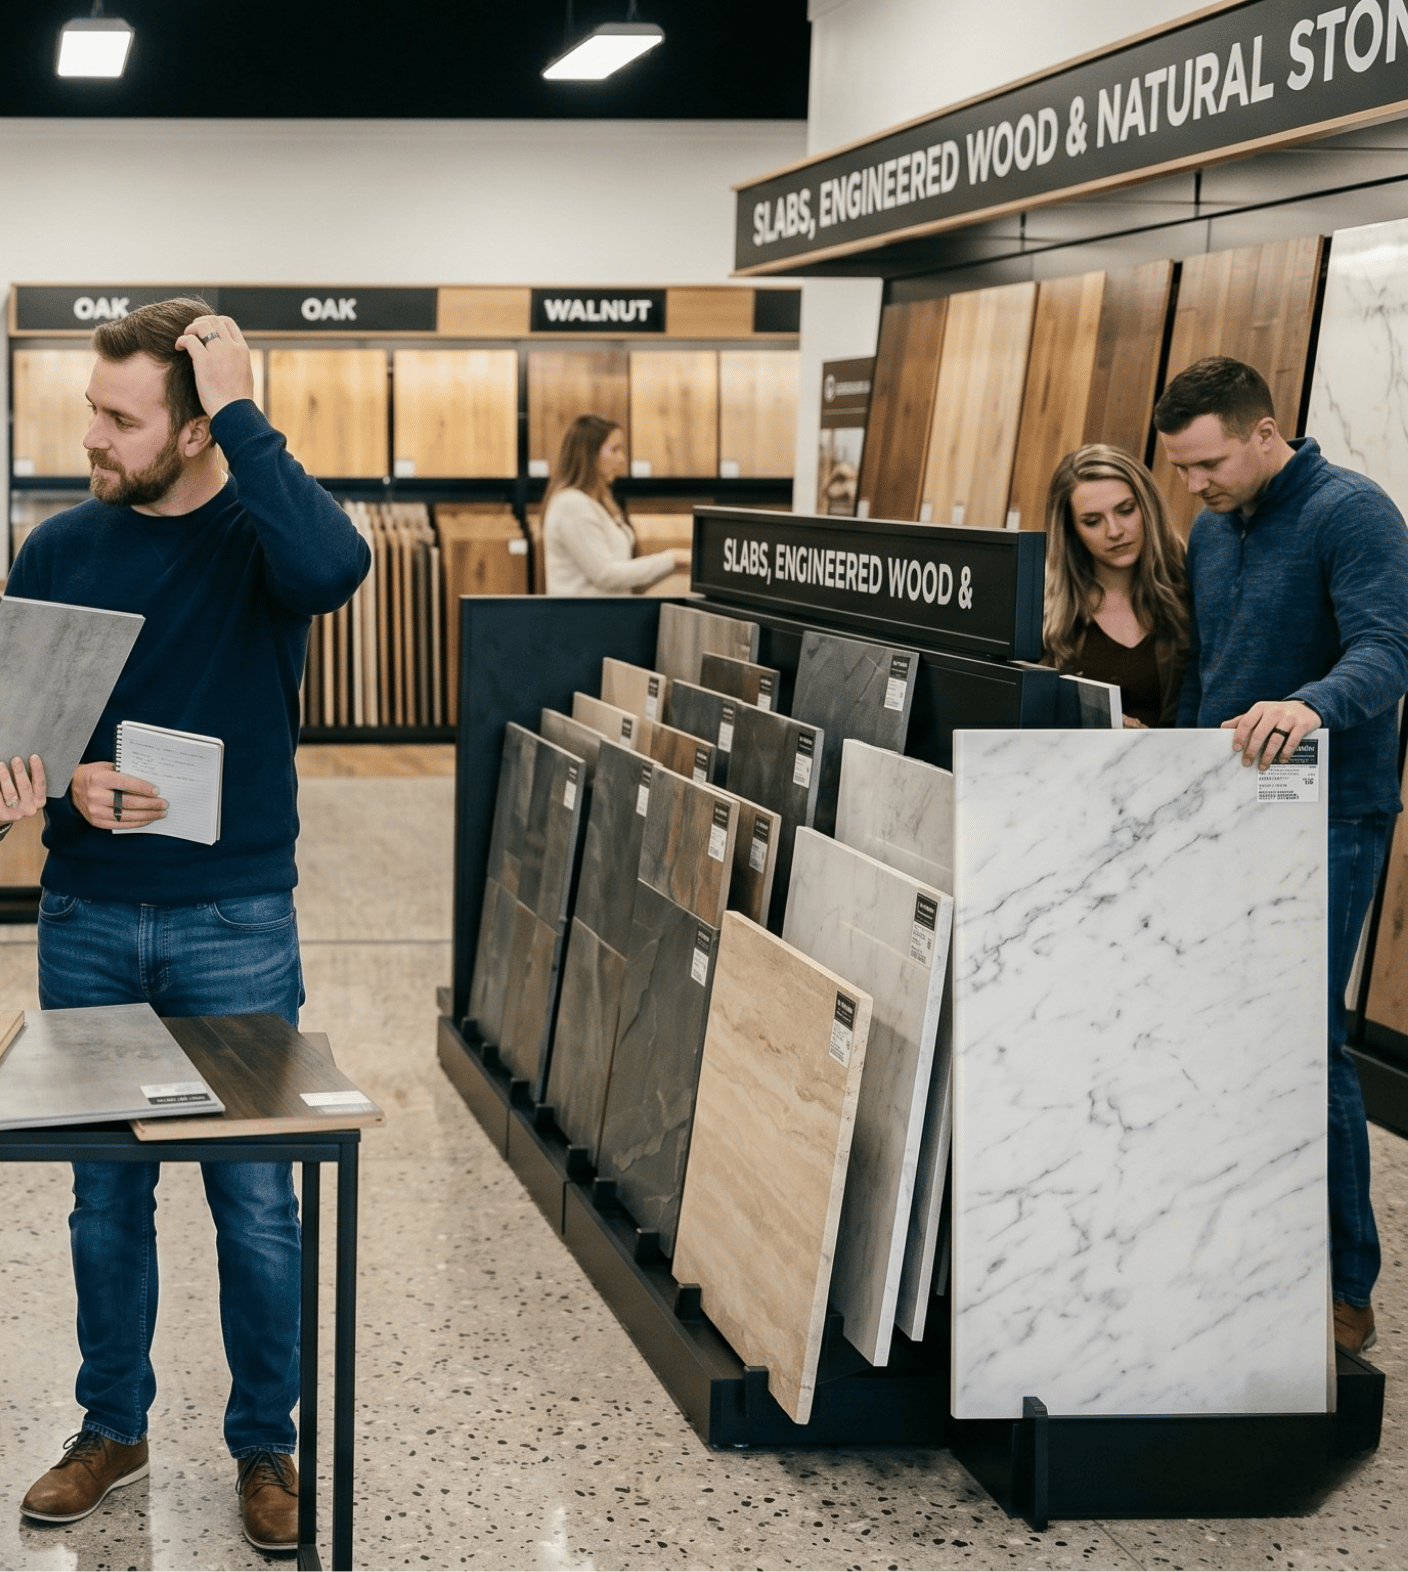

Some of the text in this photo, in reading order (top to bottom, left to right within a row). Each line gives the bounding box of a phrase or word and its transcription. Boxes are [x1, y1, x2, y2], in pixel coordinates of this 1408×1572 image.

[752, 188, 817, 247] SLABS,
[818, 139, 960, 229] ENGINEERED
[966, 106, 1059, 186] WOOD
[1065, 97, 1089, 157] &
[1096, 34, 1275, 149] NATURAL
[73, 296, 130, 320] OAK
[300, 297, 358, 321] OAK
[543, 298, 653, 322] WALNUT
[723, 537, 973, 611] SLABS, ENGINEERED WOOD &
